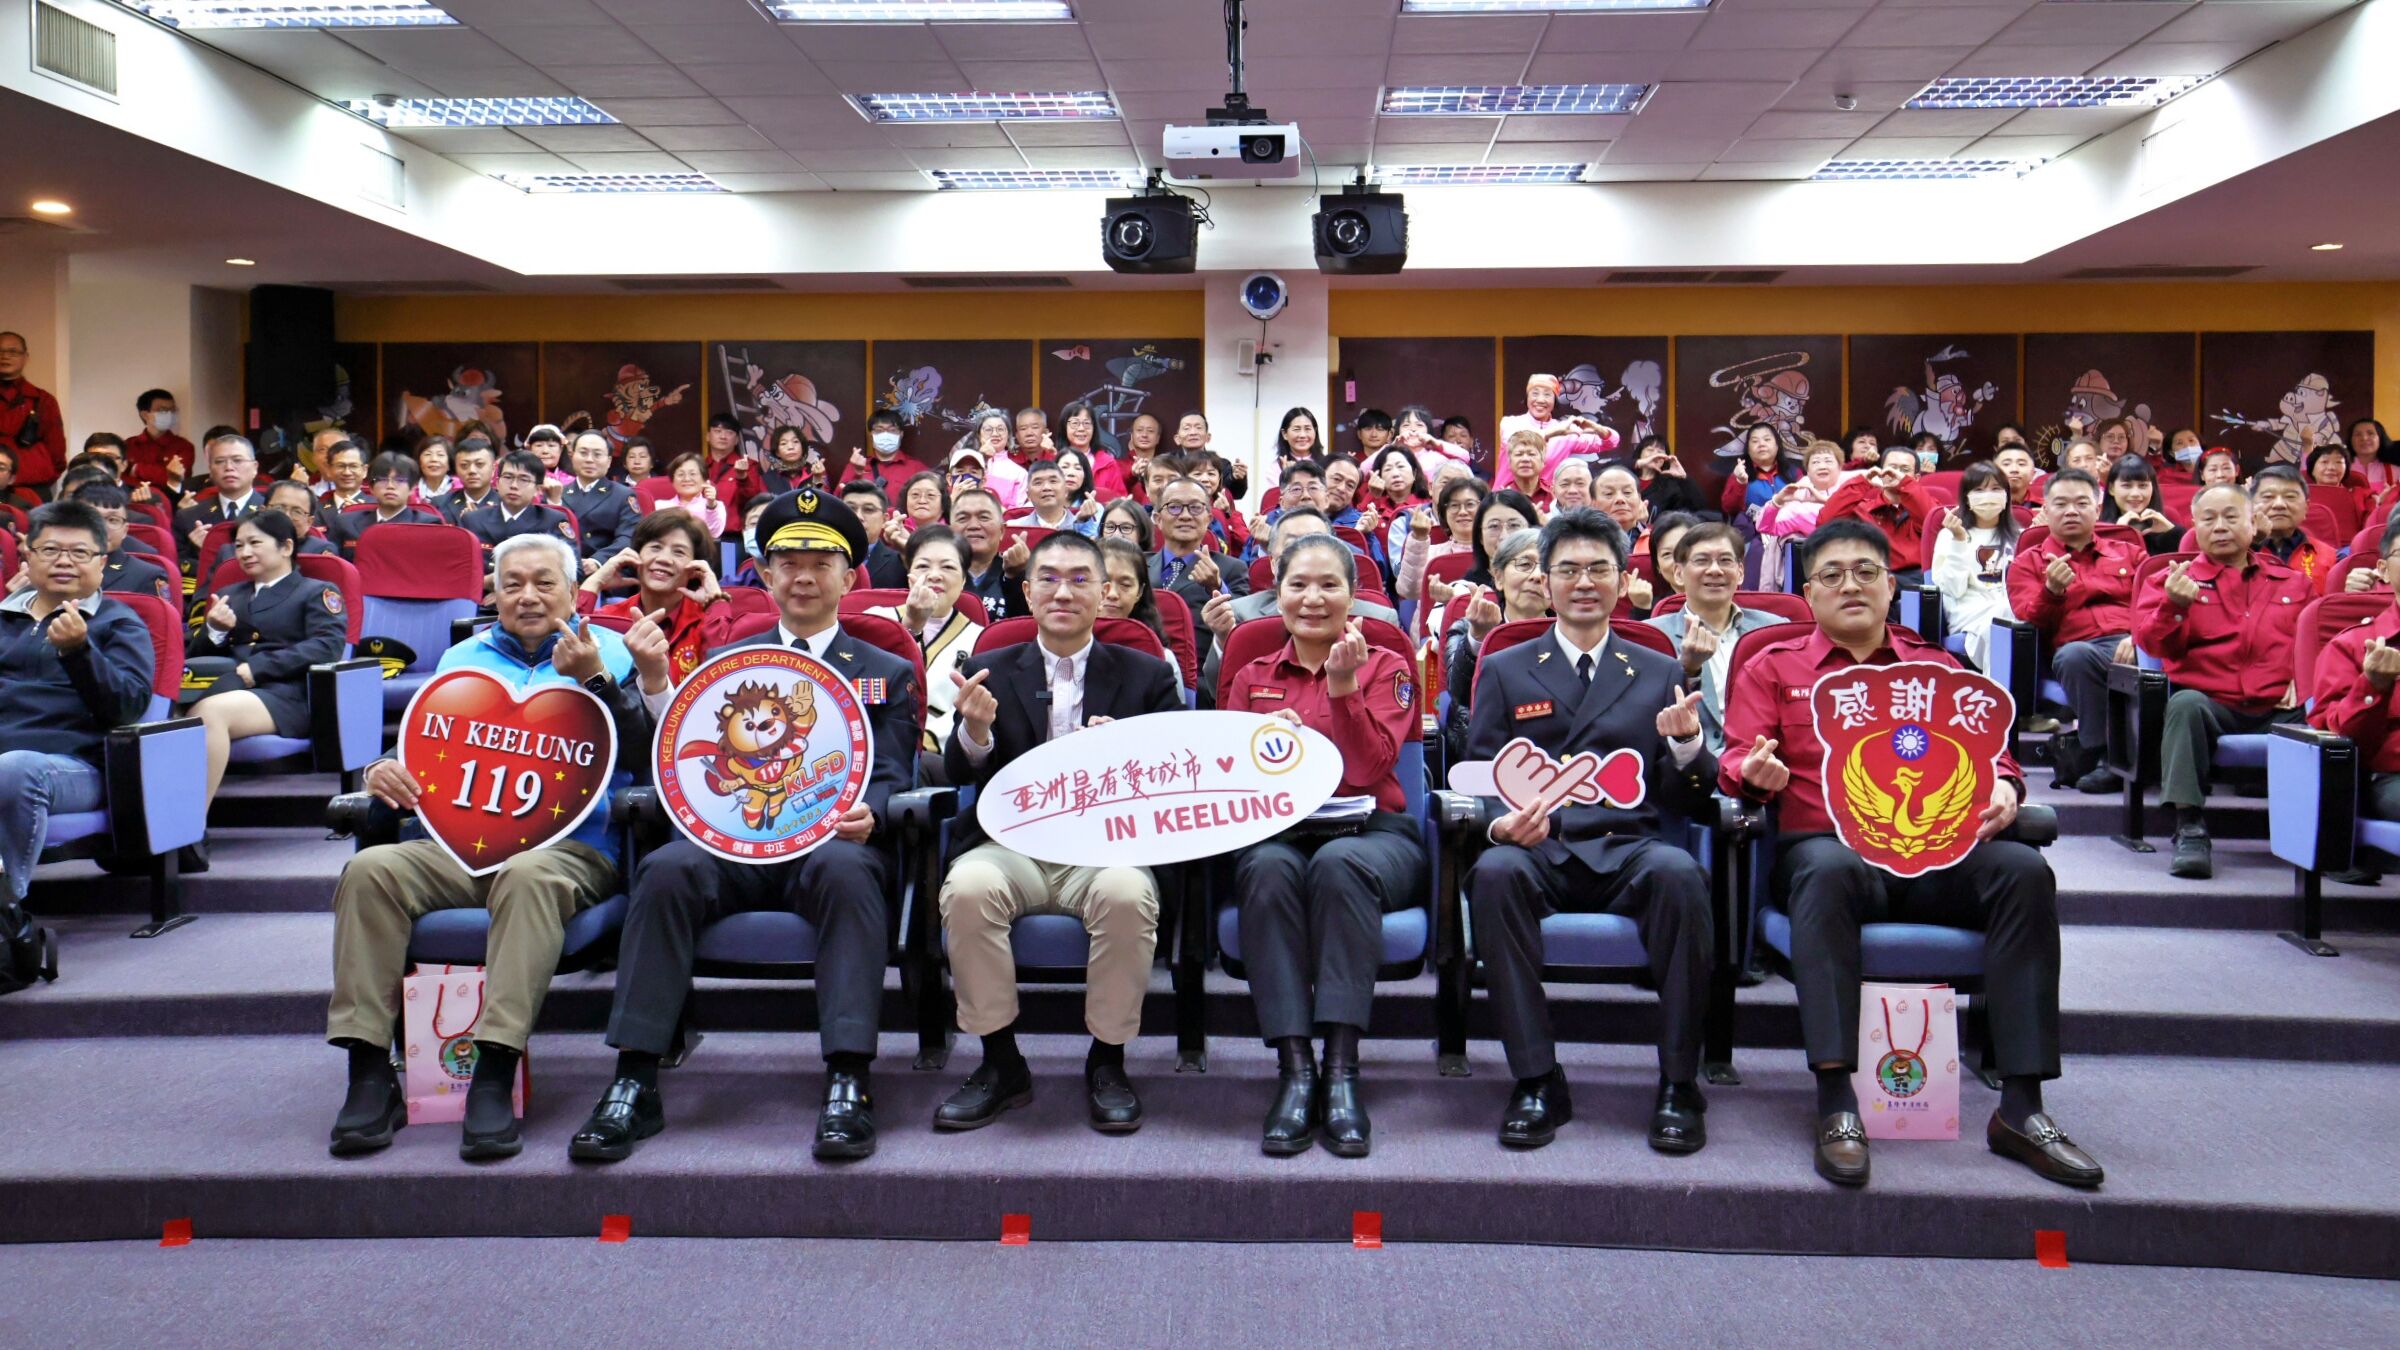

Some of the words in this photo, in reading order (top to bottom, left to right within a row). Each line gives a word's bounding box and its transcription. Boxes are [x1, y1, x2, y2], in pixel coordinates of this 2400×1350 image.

[709, 658, 740, 679] FIRE
[742, 654, 830, 683] DEPARTMENT
[684, 675, 708, 701] CITY
[831, 682, 852, 709] 119
[1829, 677, 1997, 735] 感謝您
[421, 712, 455, 741] IN
[464, 720, 595, 767] KEELUNG
[662, 702, 687, 762] KEELUNG
[664, 768, 679, 797] 119
[760, 761, 782, 781] 119
[783, 751, 846, 797] KLFD
[451, 759, 542, 817] 119
[1105, 814, 1137, 842] IN
[1153, 791, 1295, 835] KEELUNG
[764, 842, 786, 854] 中正
[794, 829, 817, 846] 中山
